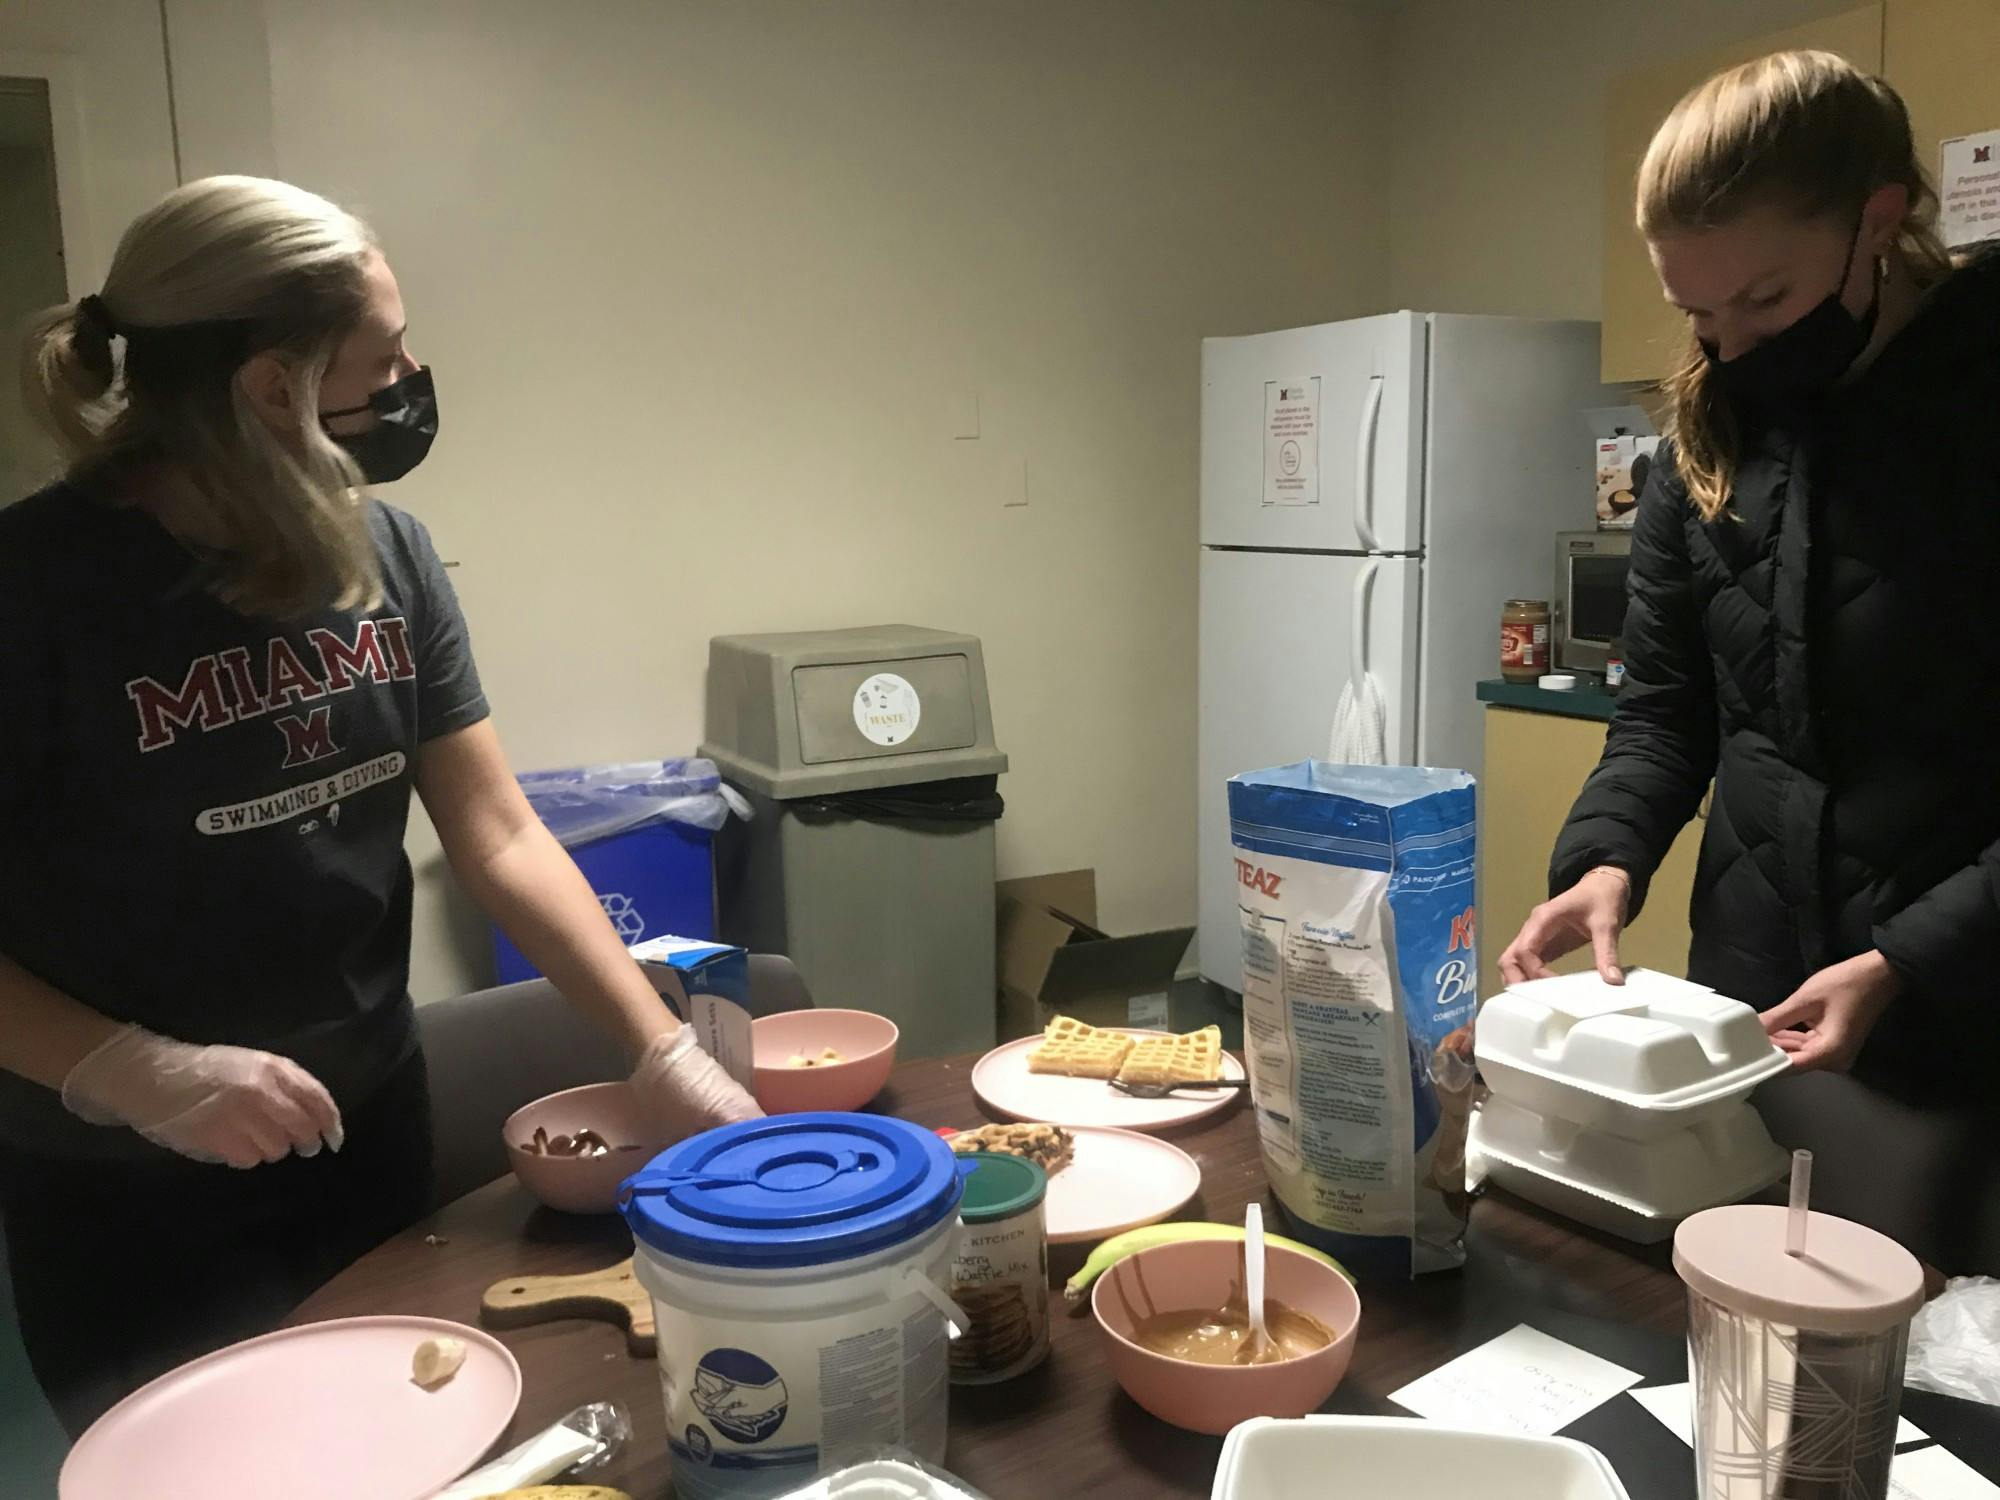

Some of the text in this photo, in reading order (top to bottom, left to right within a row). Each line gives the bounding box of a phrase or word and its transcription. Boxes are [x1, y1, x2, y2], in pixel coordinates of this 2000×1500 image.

[125, 617, 416, 753] MIAMI
[274, 705, 342, 769] M
[209, 756, 399, 830] SWIMMING & DIVING
[971, 1230, 1025, 1247] KITCHEN
